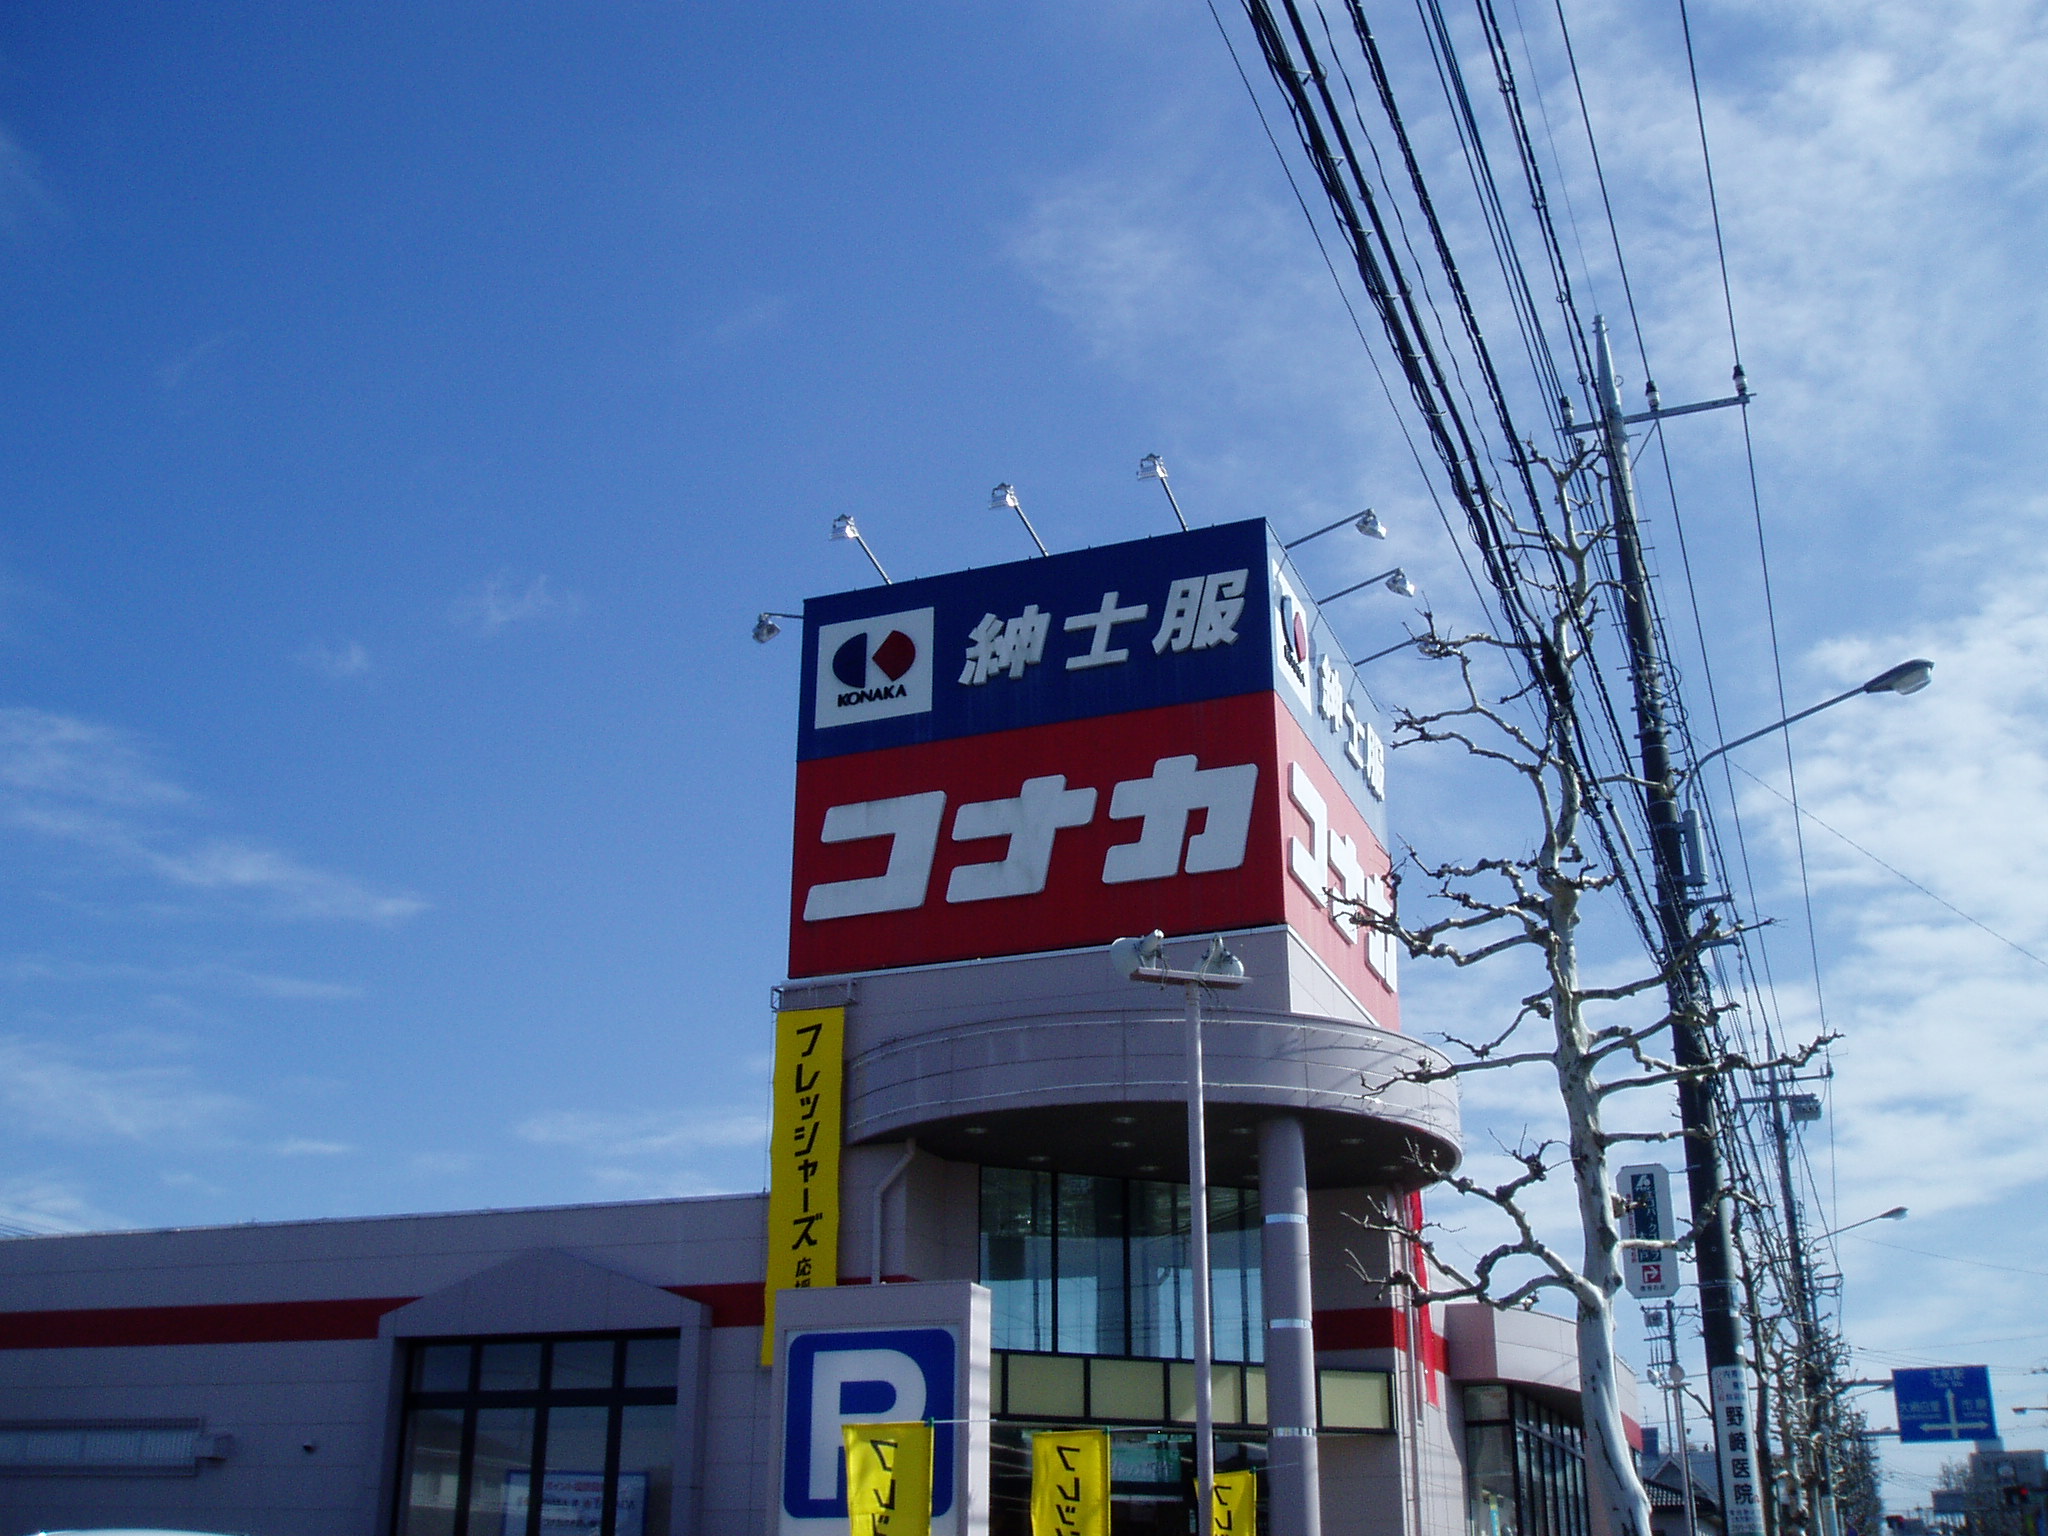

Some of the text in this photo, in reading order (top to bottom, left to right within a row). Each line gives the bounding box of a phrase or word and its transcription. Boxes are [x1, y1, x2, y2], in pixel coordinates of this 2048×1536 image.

[958, 568, 1249, 686] 紳士服
[837, 685, 907, 707] KONAKA
[803, 754, 1258, 921] コナカ
[808, 1349, 928, 1500] P
